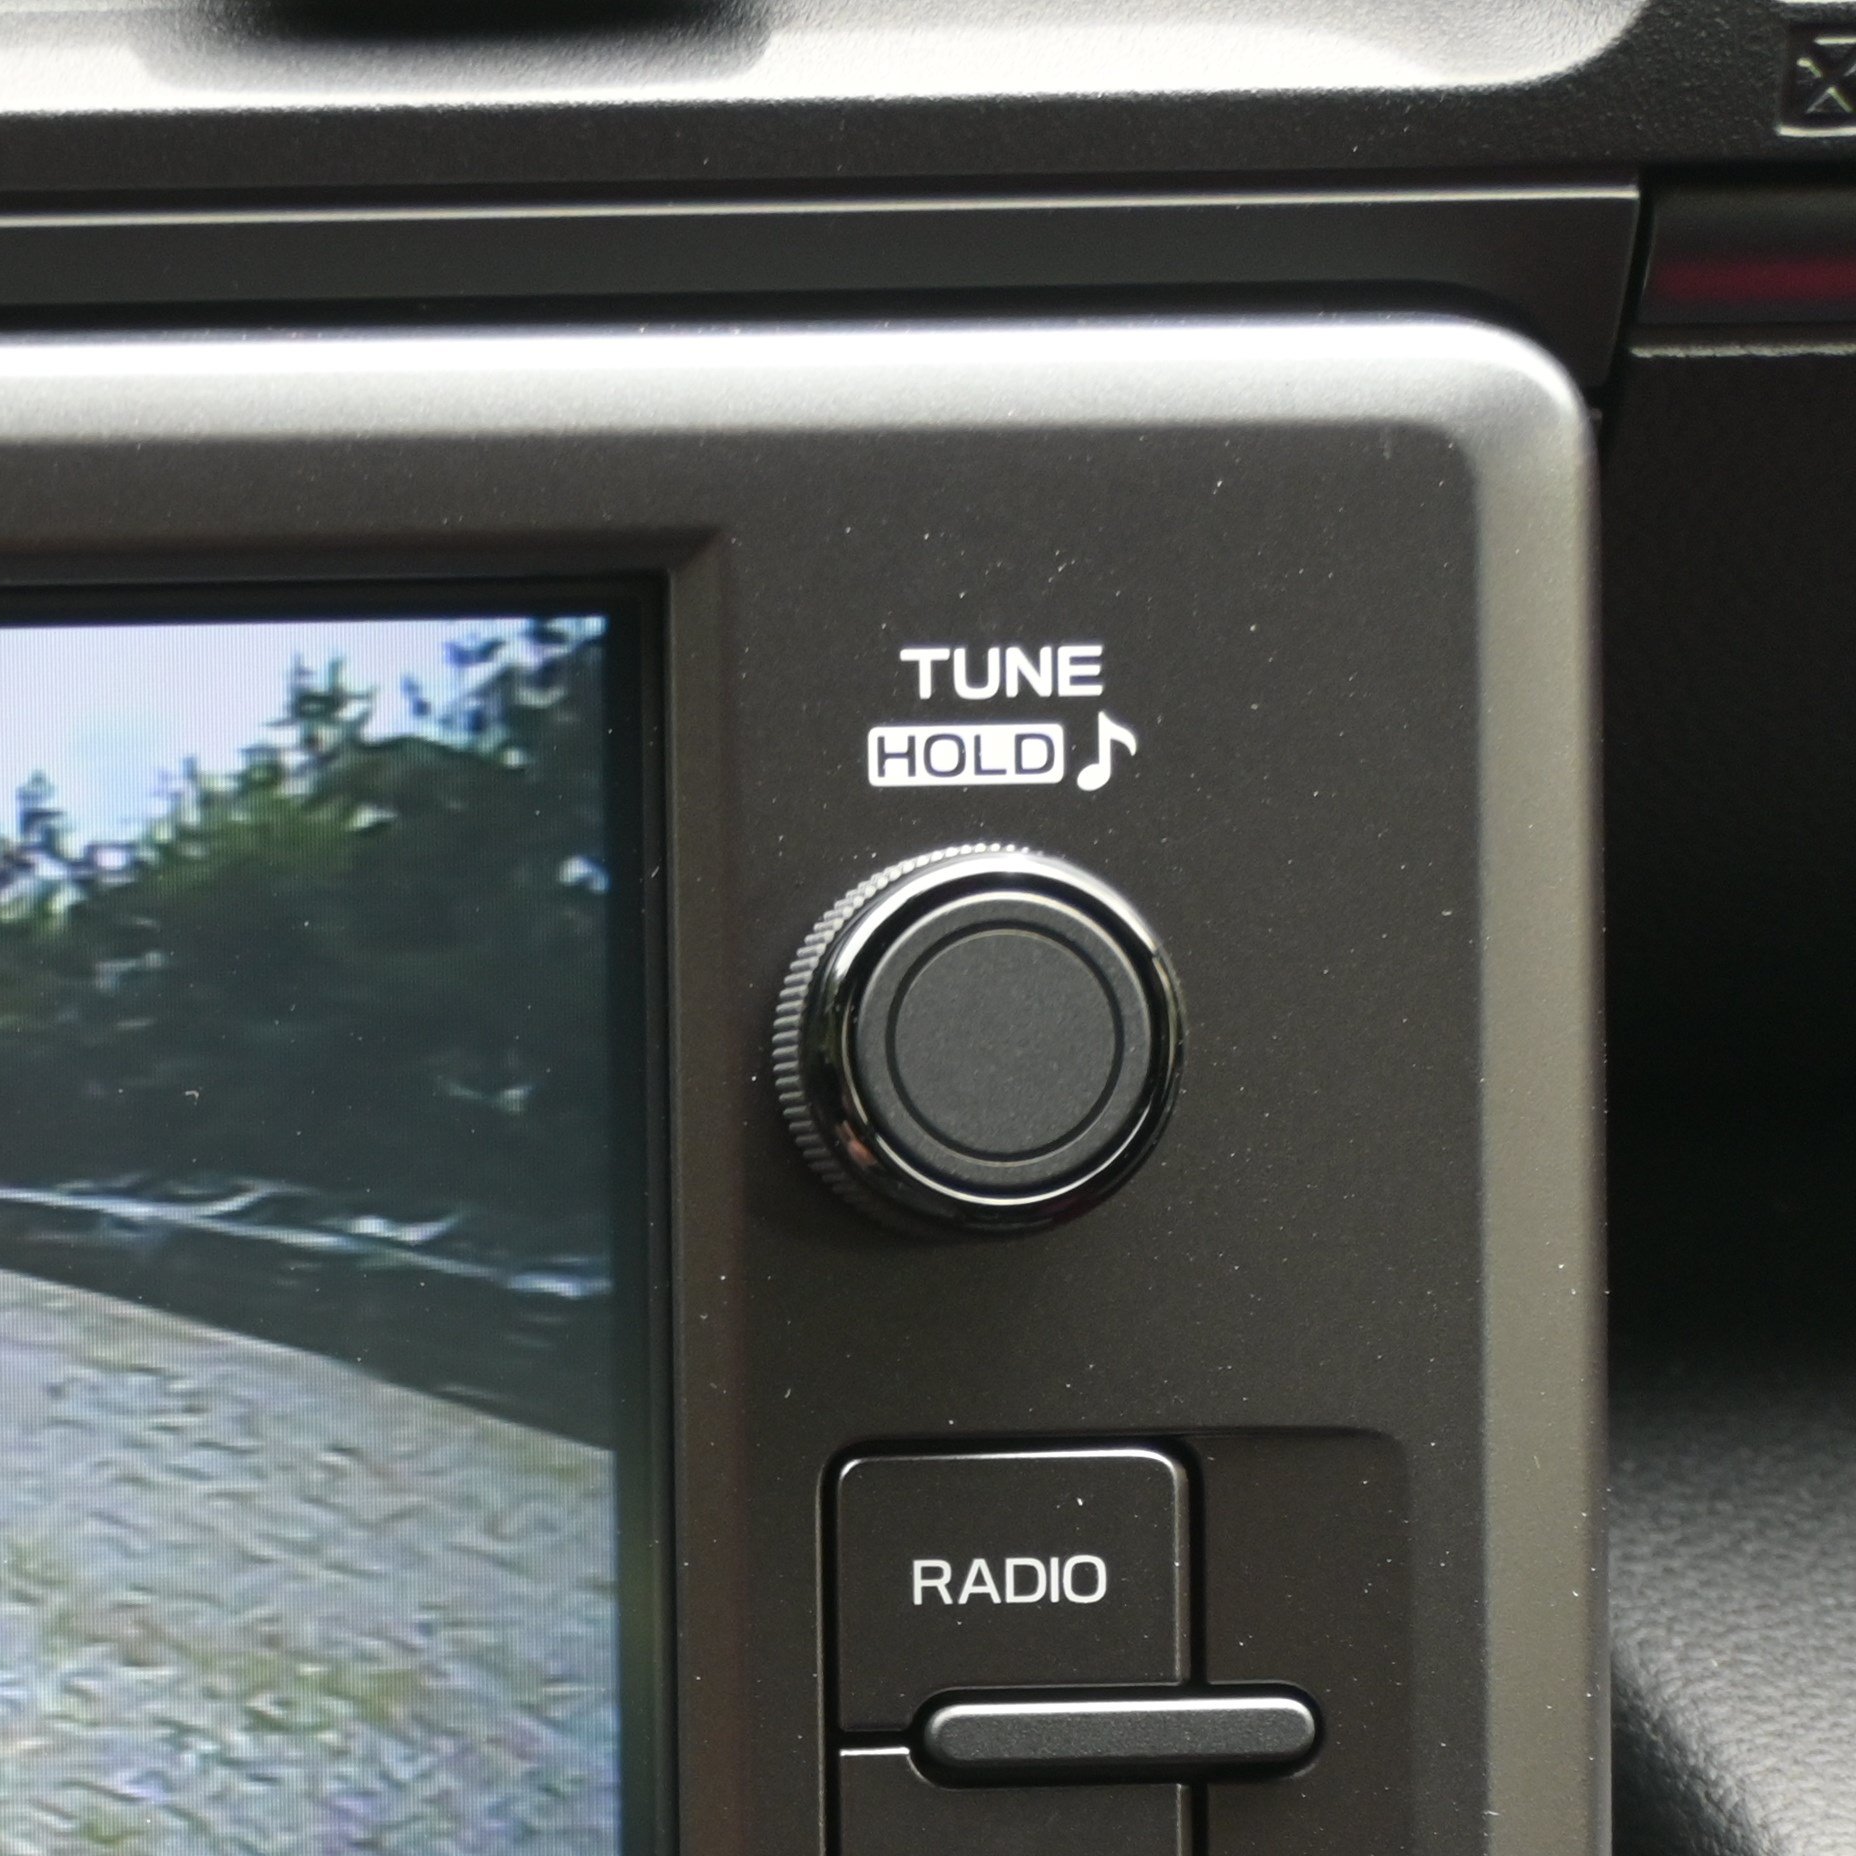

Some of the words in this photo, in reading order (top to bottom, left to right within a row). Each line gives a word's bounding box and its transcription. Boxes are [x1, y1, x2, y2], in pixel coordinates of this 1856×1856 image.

[900, 643, 1105, 701] TUNE
[874, 731, 1058, 779] HOLD
[912, 1554, 1108, 1606] RADIO
